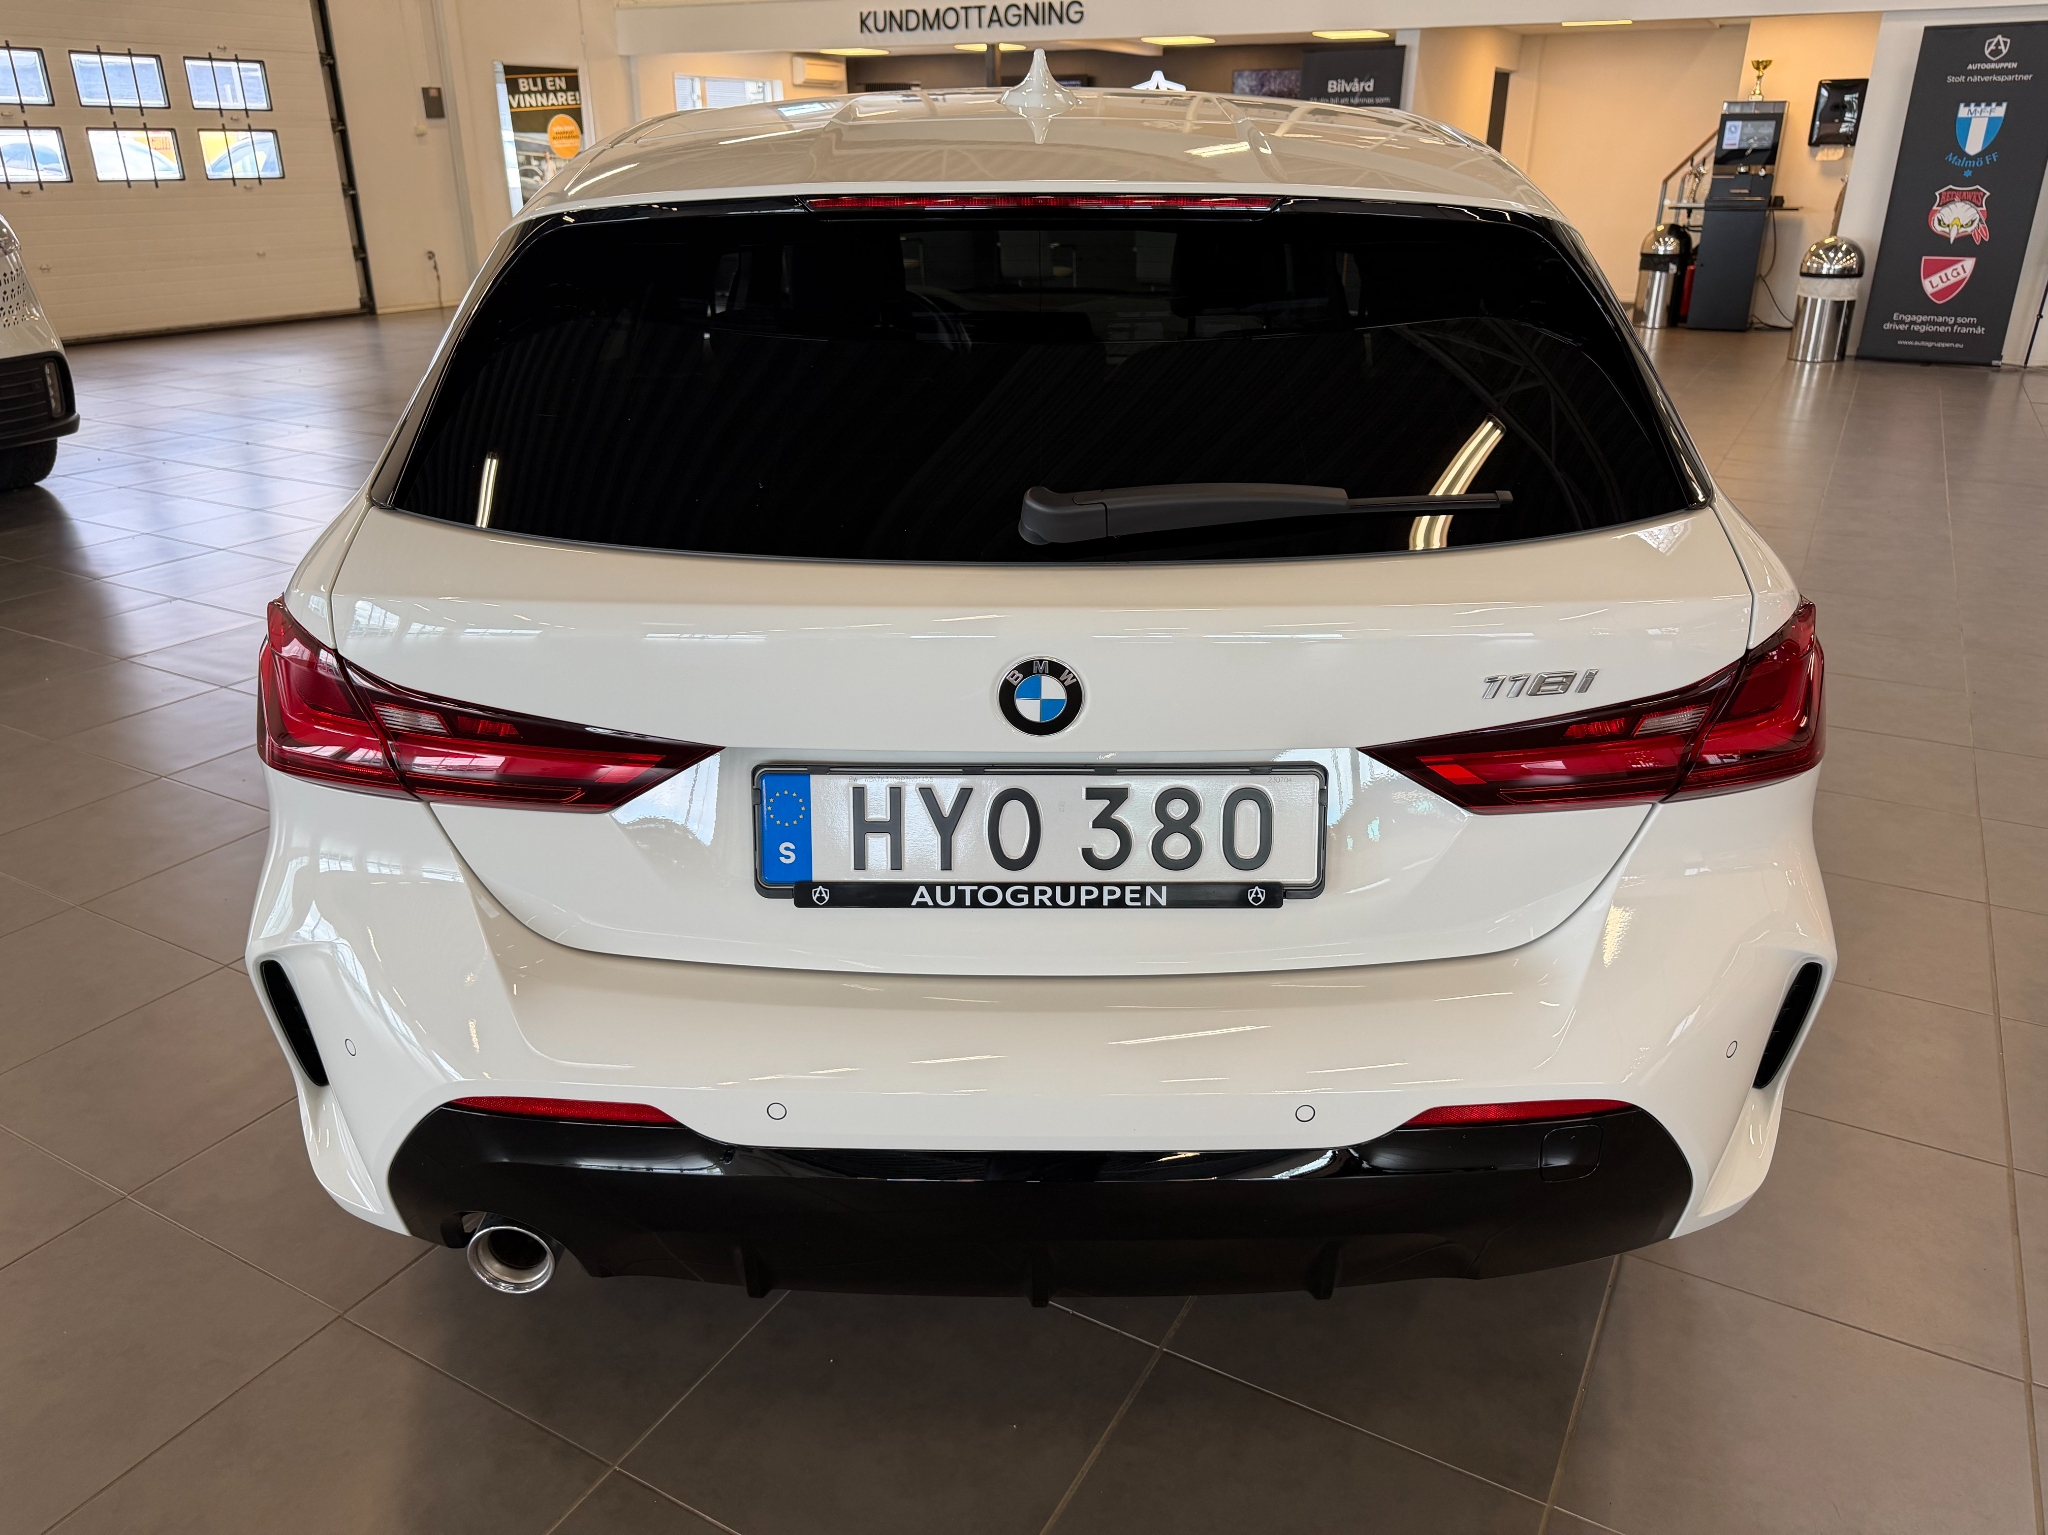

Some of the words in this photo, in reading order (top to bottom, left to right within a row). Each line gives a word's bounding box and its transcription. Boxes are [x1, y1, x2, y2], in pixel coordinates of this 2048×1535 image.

[859, 0, 1085, 34] KUNDMOTTAGNING
[1967, 62, 2018, 70] AUTOGRUPPEN
[518, 78, 542, 92] BLI
[546, 76, 567, 91] EN
[1327, 77, 1375, 93] Bilvård
[1946, 75, 1965, 83] Stolt
[1967, 73, 2033, 82] nätverkspartner
[509, 92, 581, 108] VINNARE!
[1945, 152, 1983, 167] Malmö
[1985, 152, 1999, 165] FF
[1929, 264, 1967, 289] LUGI
[1893, 312, 1955, 324] Engagemang
[1883, 322, 1909, 331] driver
[1910, 324, 1951, 333] regionen
[1953, 325, 1985, 334] framåt
[1897, 340, 1964, 348] www.autogruppen.eu
[1006, 660, 1077, 687] BMW
[1482, 668, 1600, 700] 118i
[1080, 786, 1275, 871] 380
[778, 842, 796, 865] S
[911, 885, 1167, 906] AUTOGRUPPEN
